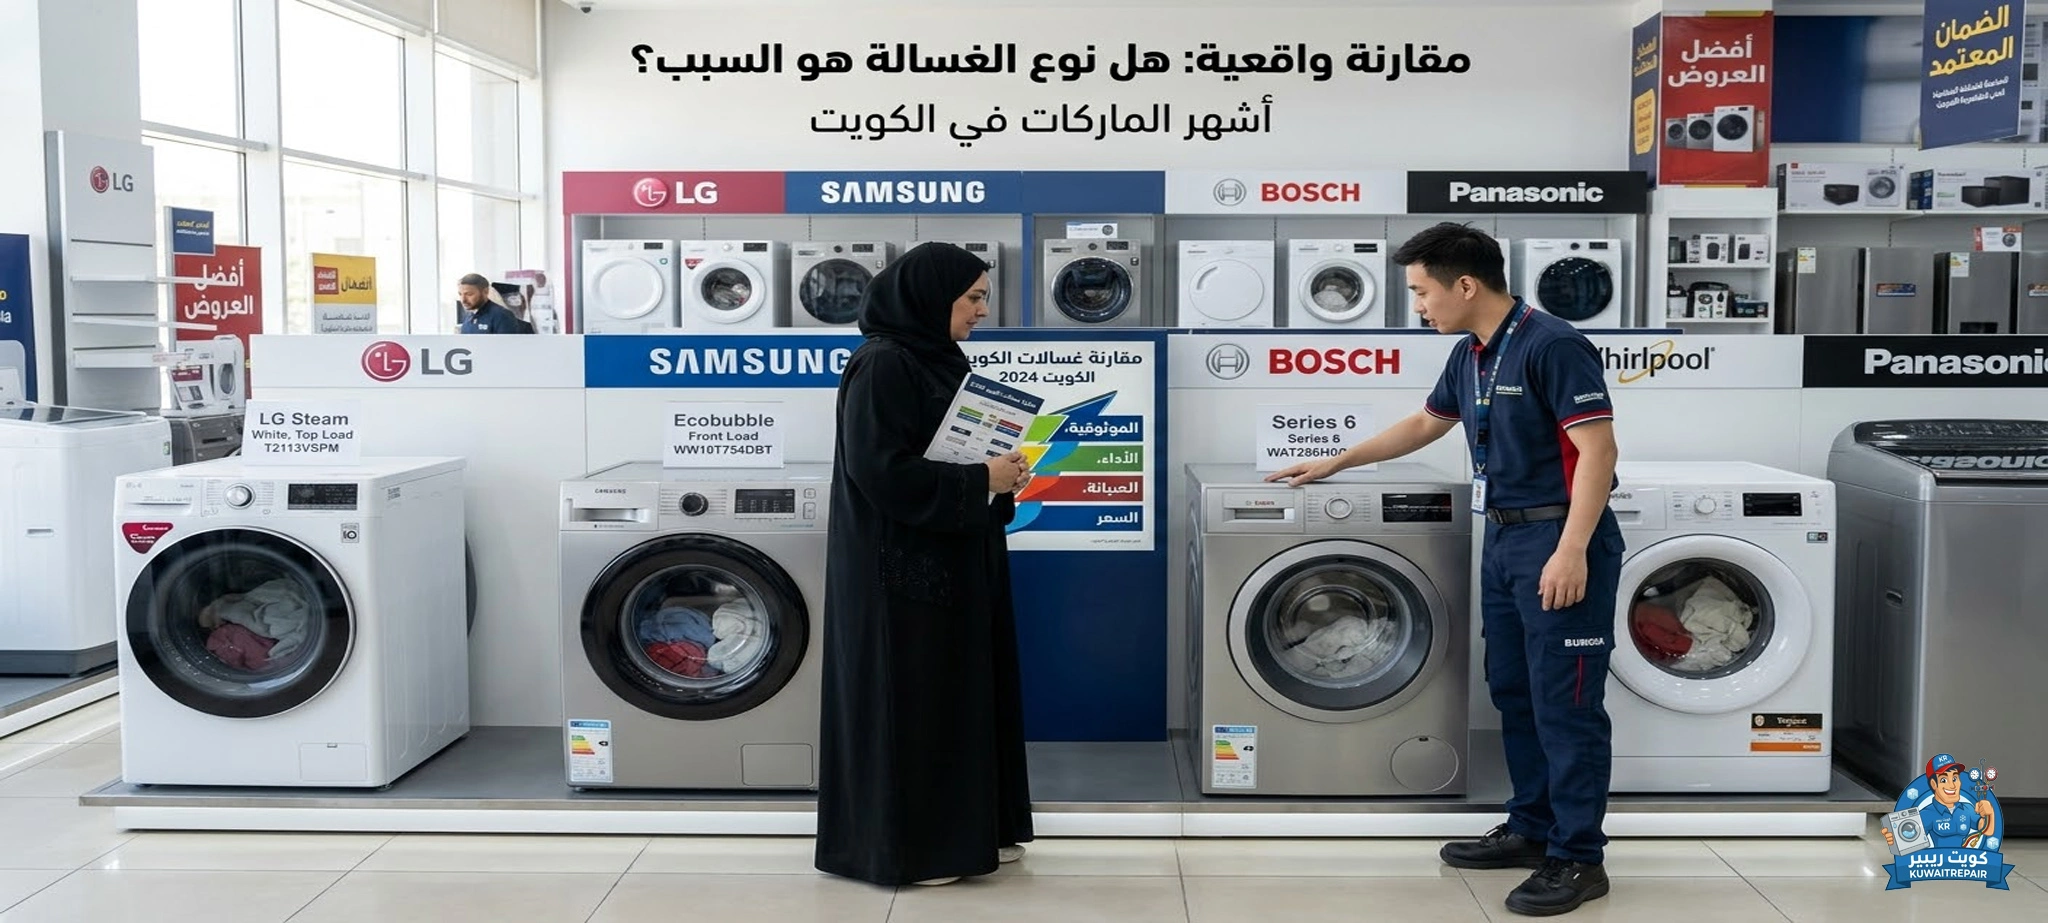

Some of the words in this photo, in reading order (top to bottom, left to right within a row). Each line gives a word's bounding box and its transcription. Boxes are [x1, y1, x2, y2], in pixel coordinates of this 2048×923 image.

[1935, 4, 2009, 48] الضمان
[1681, 33, 1753, 63] أفضل
[1929, 35, 2014, 77] المعتمد
[1667, 64, 1766, 88] العروض
[113, 172, 134, 192] LG
[1450, 181, 1604, 202] Panasonic
[675, 181, 718, 204] LG
[821, 181, 986, 204] SAMSUNG
[1261, 183, 1360, 202] BOSCH
[194, 258, 244, 291] أفضل
[184, 294, 254, 320] العروض
[421, 348, 473, 375] LG
[649, 348, 851, 375] SAMSUNG
[966, 350, 1012, 367] الكوي
[1017, 350, 1084, 365] غسالات
[1088, 350, 1143, 368] مقارنة
[1269, 348, 1400, 374] BOSCH
[1599, 346, 1710, 377] hirlpool
[1864, 348, 2048, 374] Panasoni
[999, 371, 1038, 383] 2024
[1043, 371, 1095, 386] الكويت
[259, 412, 285, 425] LG
[291, 412, 349, 425] Steam
[674, 413, 775, 427] Ecobubble
[1272, 414, 1338, 429] Series
[1343, 414, 1357, 429] 6
[295, 430, 318, 441] Top
[322, 430, 354, 440] Load
[688, 431, 723, 441] Front
[726, 431, 759, 441] Load
[1287, 434, 1329, 443] Series
[264, 442, 340, 452] T2113VSPM
[673, 445, 773, 455] WW10T754DBT
[1096, 511, 1138, 526] السعر
